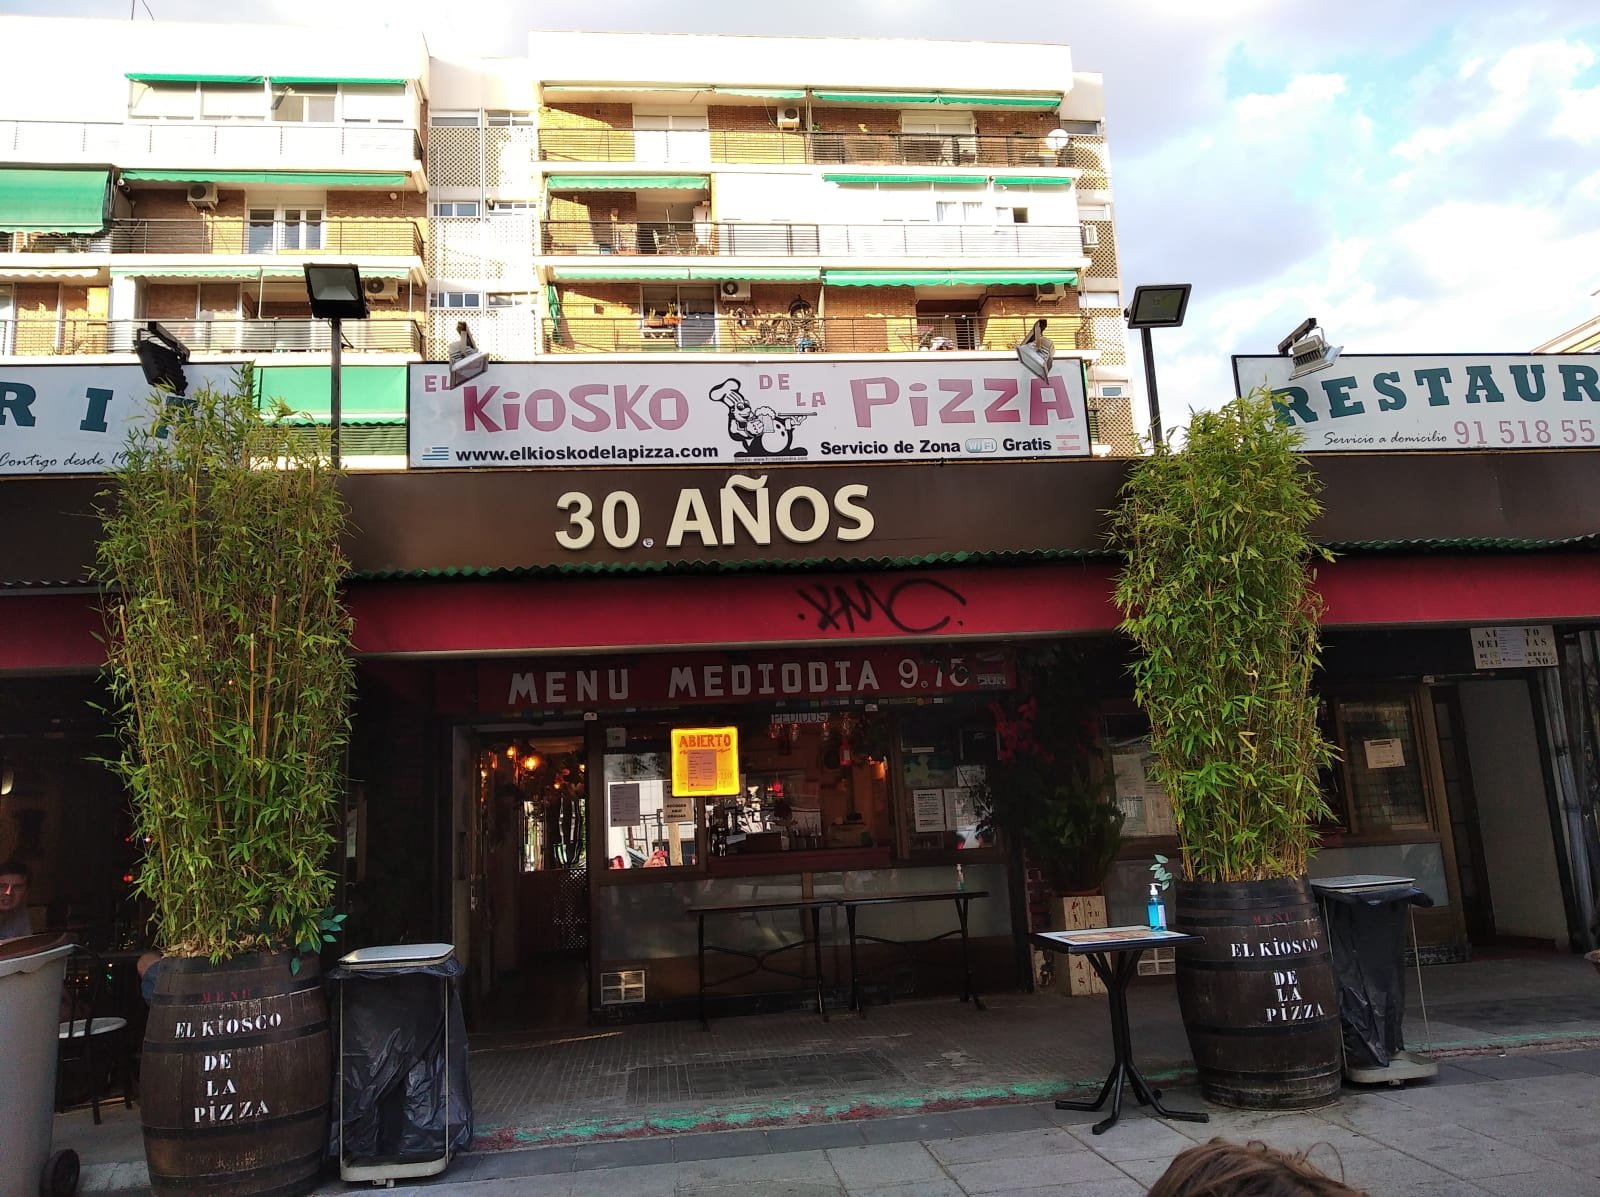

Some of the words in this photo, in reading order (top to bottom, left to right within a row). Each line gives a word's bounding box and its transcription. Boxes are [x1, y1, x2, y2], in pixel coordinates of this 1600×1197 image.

[424, 375, 450, 392] EL
[463, 384, 690, 433] KiOSKO
[759, 373, 790, 390] DE
[796, 391, 827, 408] LA
[850, 375, 1075, 428] PiZZA
[1324, 431, 1375, 447] Servicio
[1379, 436, 1388, 444] a
[1390, 431, 1448, 445] domicilio
[1454, 420, 1486, 446] 91
[1499, 420, 1551, 445] 518
[1561, 419, 1596, 444] 55
[456, 444, 718, 463] www.elkioskodelapizza.com
[821, 440, 888, 456] Servicio
[894, 440, 914, 454] de
[920, 440, 961, 454] Zona
[1002, 437, 1052, 452] Gratis
[0, 451, 57, 472] Contigo
[64, 452, 106, 466] desde
[555, 491, 641, 550] 30
[666, 475, 876, 548] AÑOS
[508, 668, 630, 705] MENU
[669, 660, 881, 699] MEDIODIA
[679, 733, 732, 748] ABIERTO
[1230, 942, 1255, 958] EL
[1259, 936, 1319, 957] KiOSCO
[1273, 969, 1299, 986] DE
[1276, 985, 1303, 1003] LA
[1265, 1001, 1325, 1022] PiZZA
[174, 1021, 196, 1040] EL
[201, 1012, 282, 1037] KiOSCO
[204, 1052, 232, 1072] DE
[206, 1078, 238, 1097] LA
[193, 1099, 270, 1124] PiZZA
